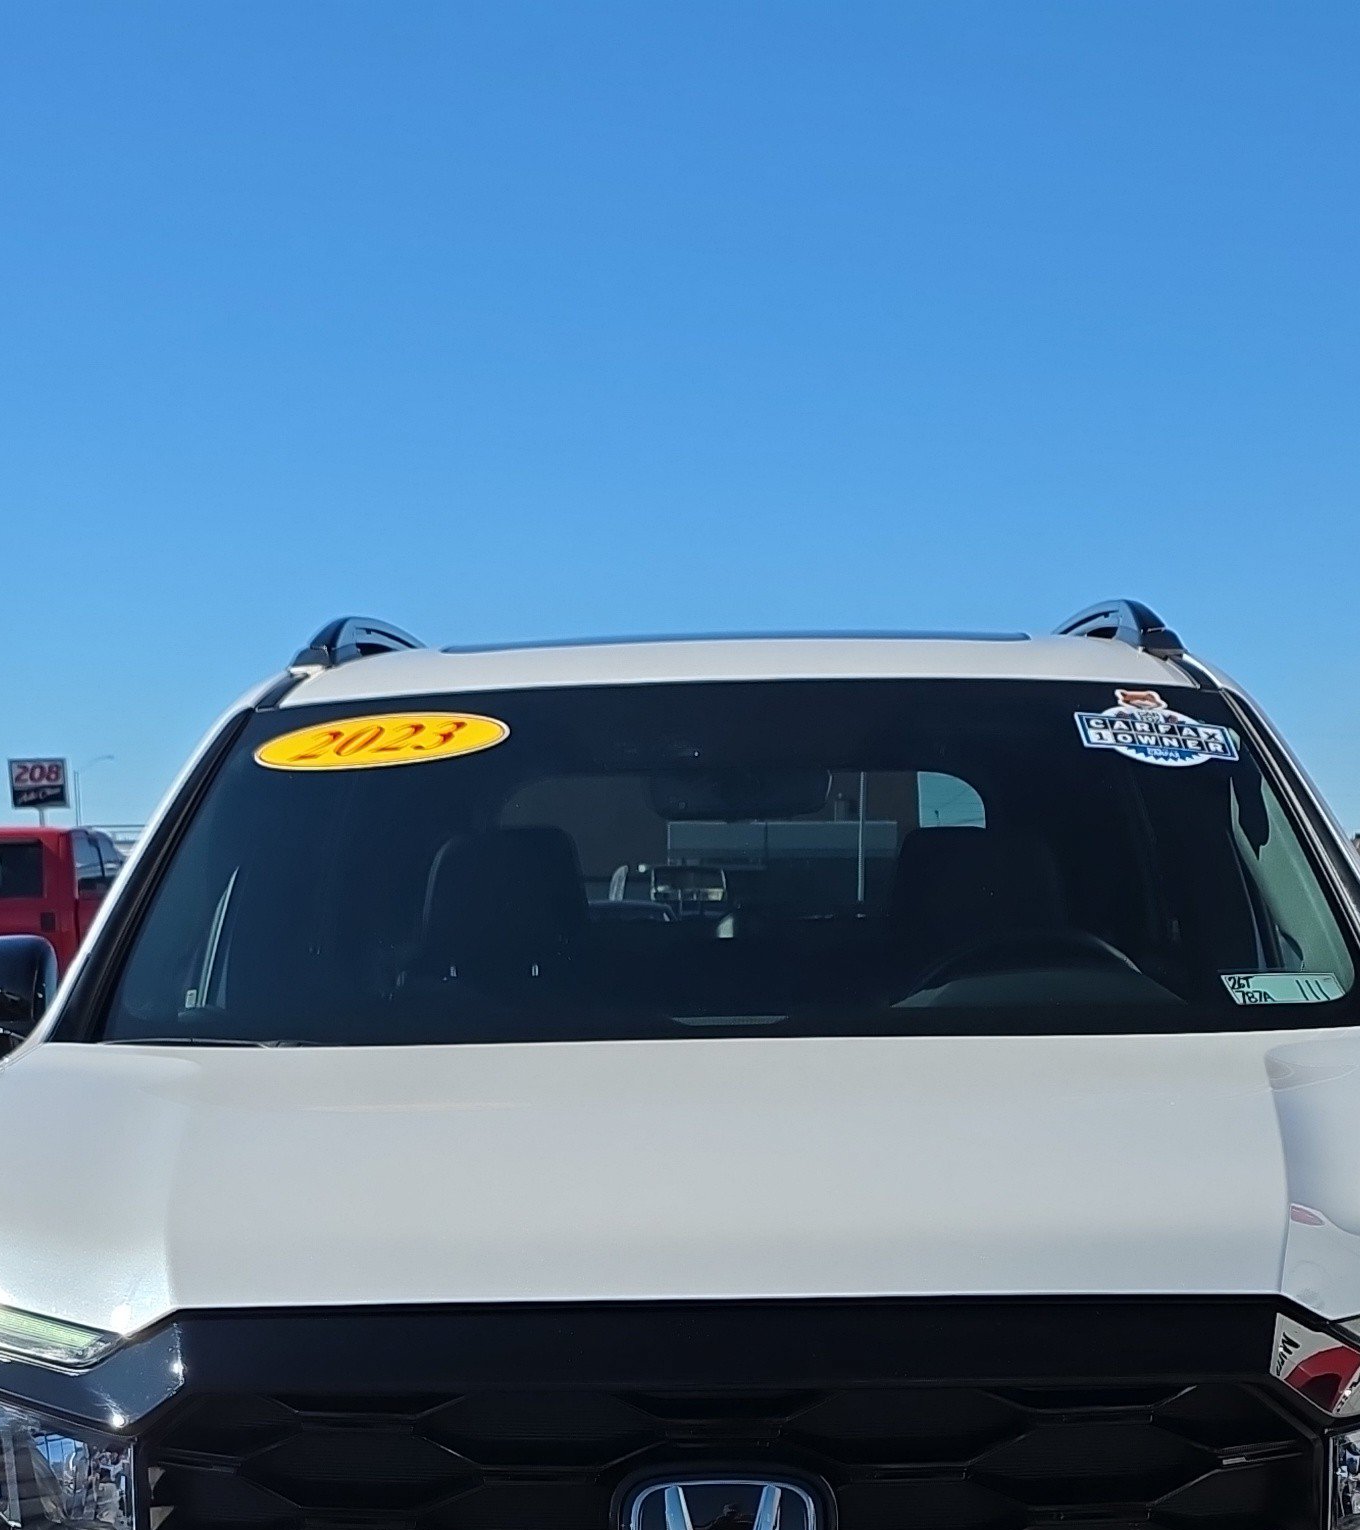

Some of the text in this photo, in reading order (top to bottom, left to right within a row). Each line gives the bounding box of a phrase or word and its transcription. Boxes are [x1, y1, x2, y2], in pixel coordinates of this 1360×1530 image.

[289, 721, 468, 763] 2023
[1089, 718, 1223, 743] CARFAX
[1116, 733, 1225, 754] OWNER
[14, 763, 61, 784] 208
